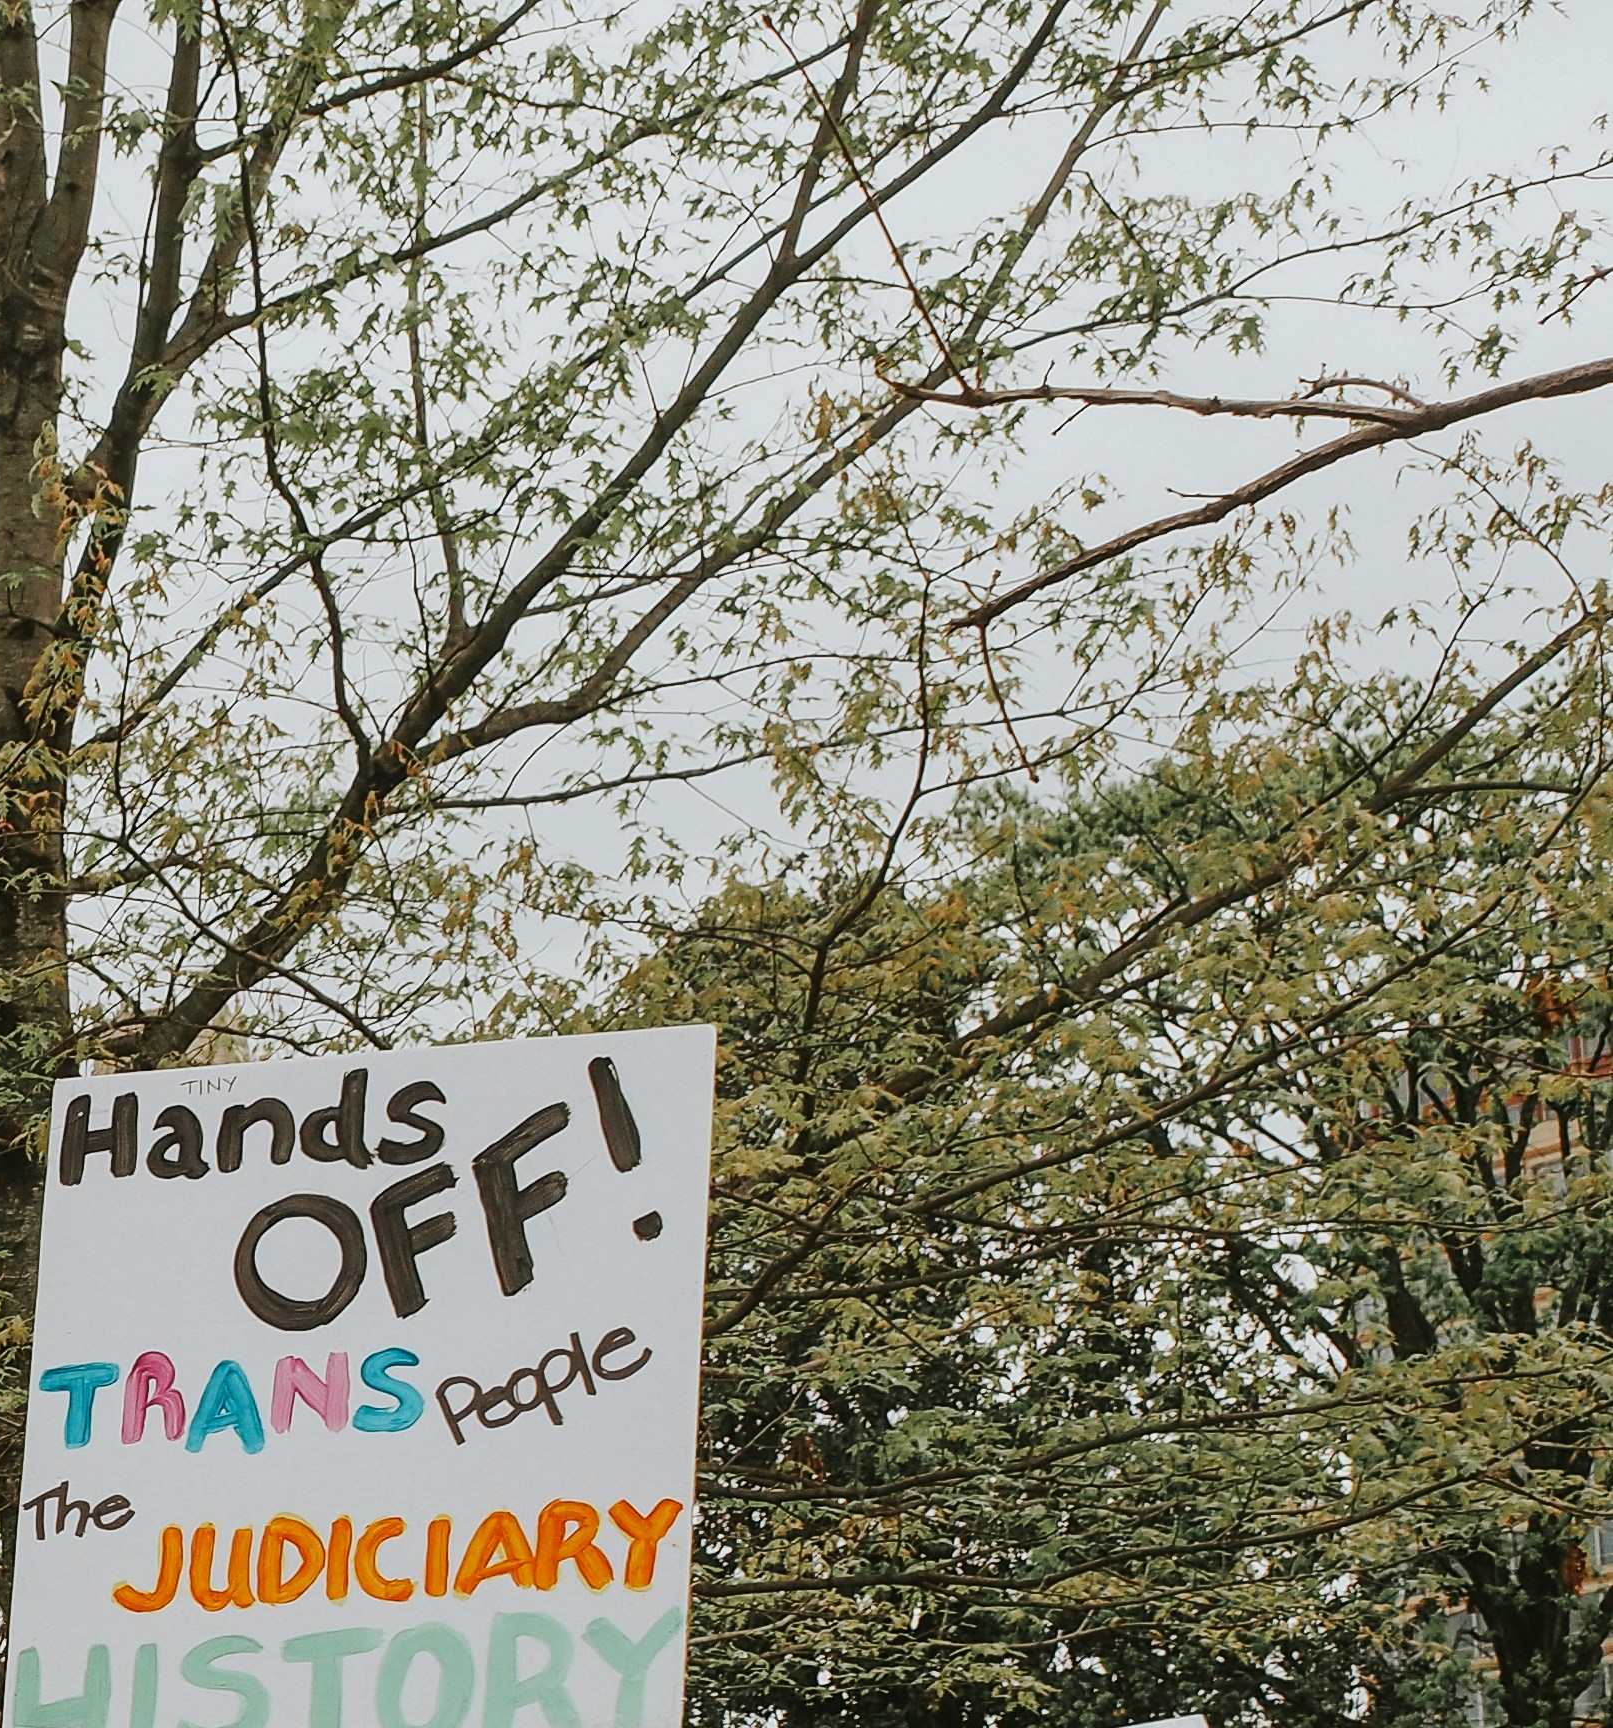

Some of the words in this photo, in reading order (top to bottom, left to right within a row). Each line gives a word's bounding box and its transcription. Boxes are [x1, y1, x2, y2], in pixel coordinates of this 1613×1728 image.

[58, 1068, 448, 1186] Hands
[180, 1076, 237, 1096] TINY
[234, 1056, 663, 1332] OFF!
[38, 1346, 425, 1455] TRANS
[434, 1325, 653, 1446] People
[21, 1481, 137, 1543] The
[112, 1498, 684, 1613] JUDICIARY
